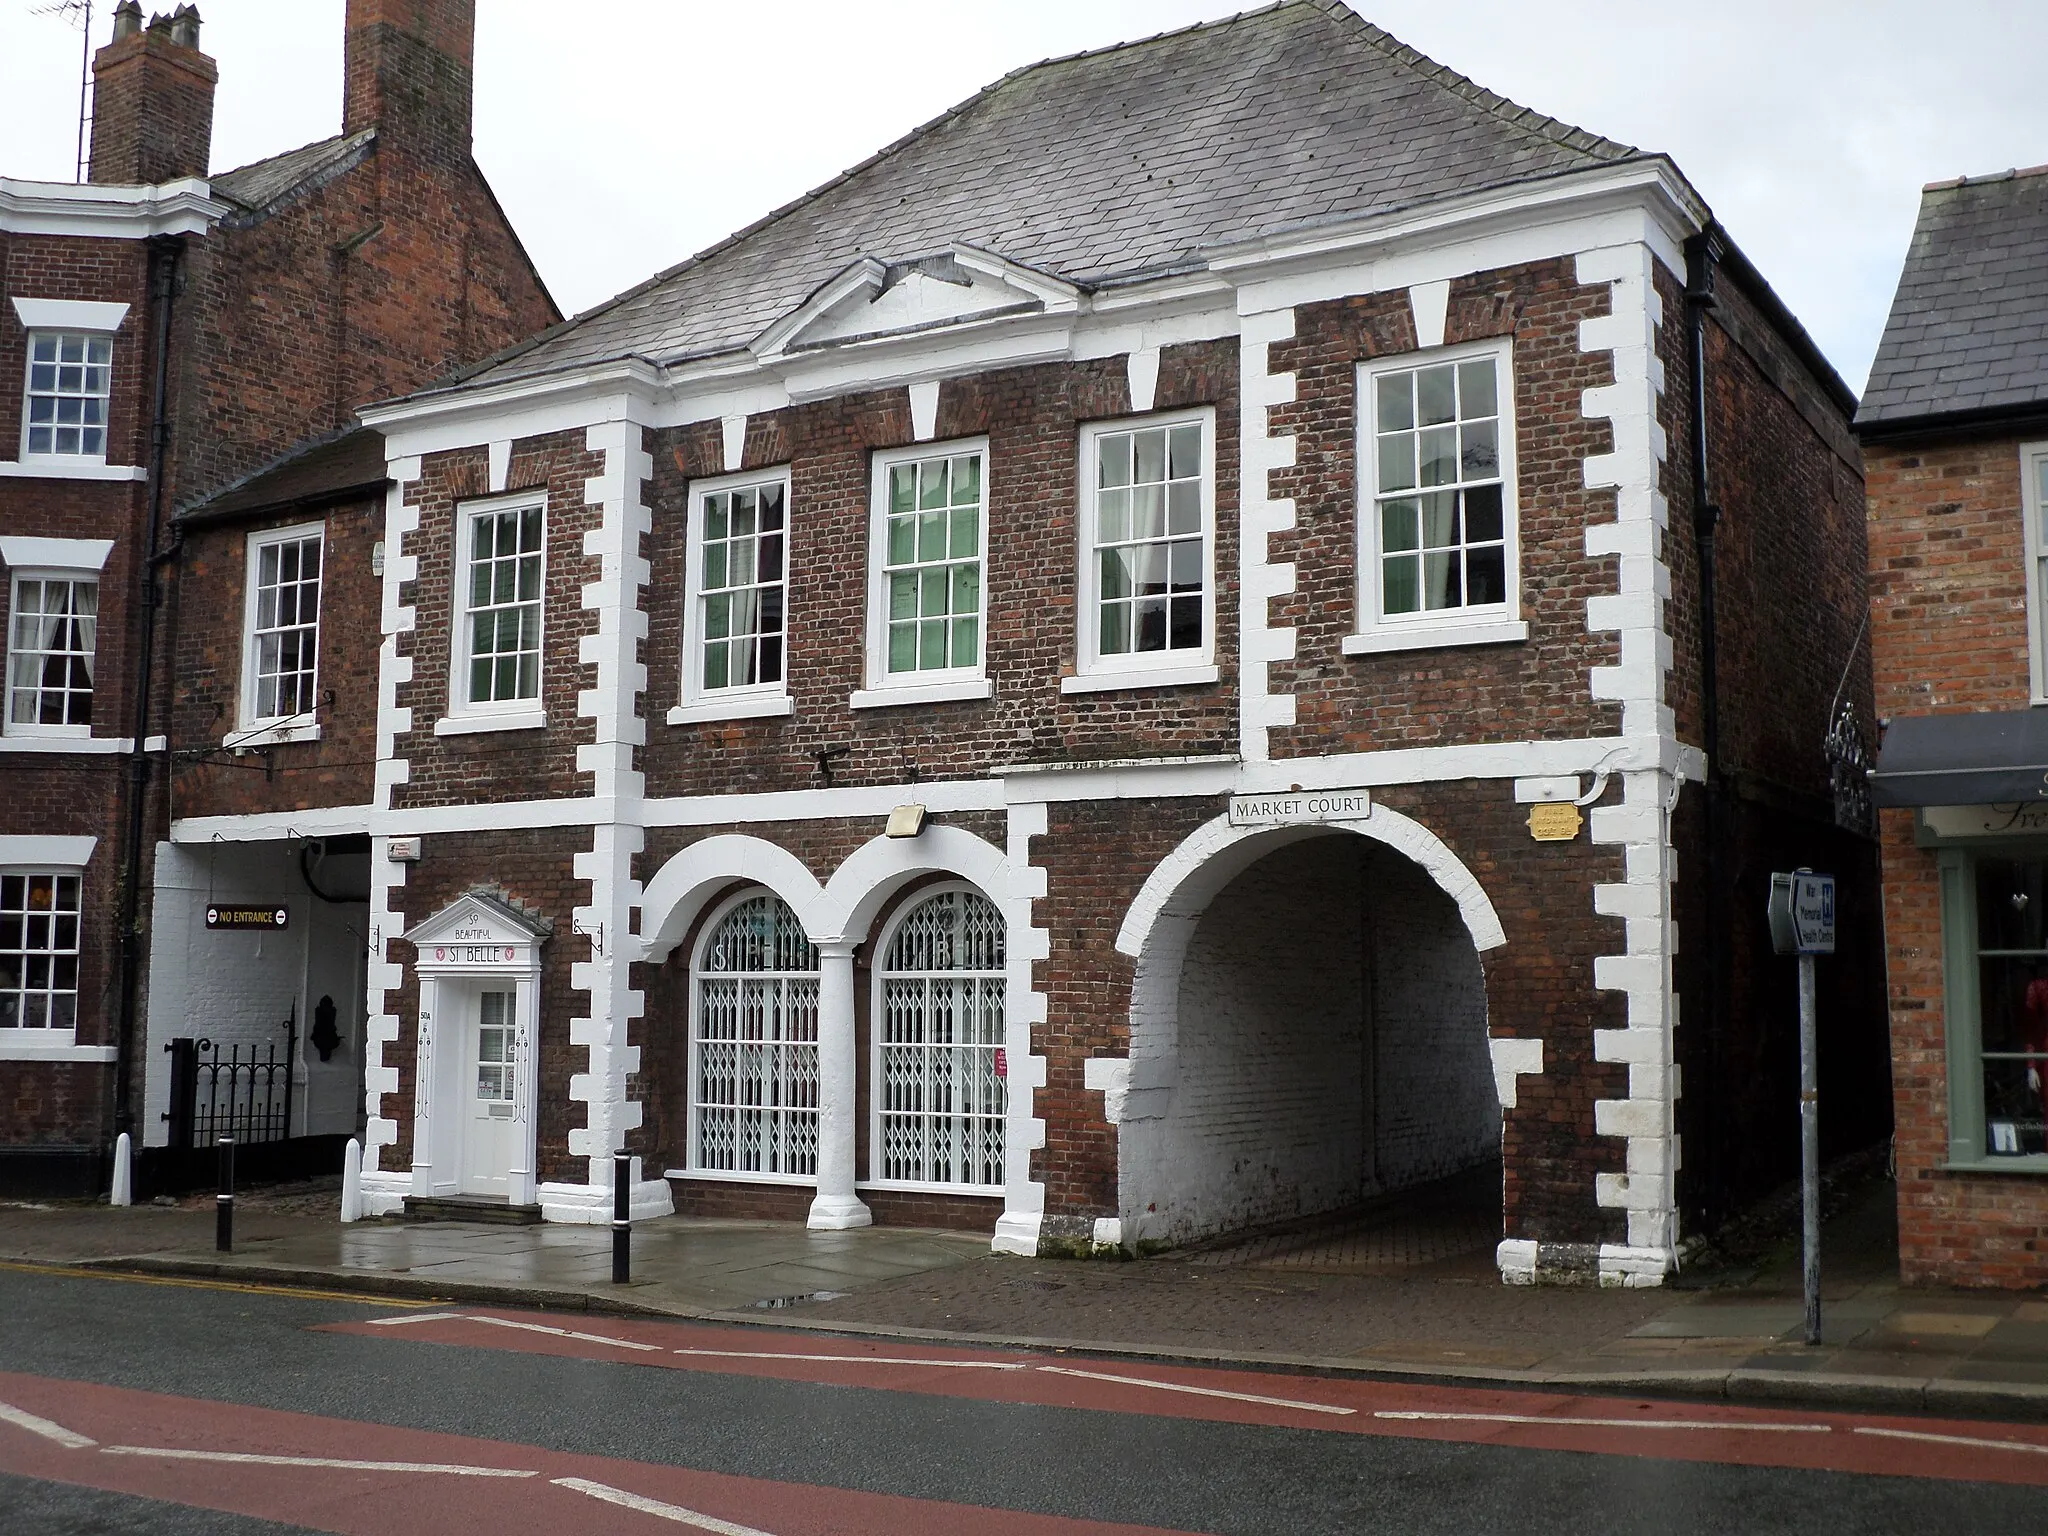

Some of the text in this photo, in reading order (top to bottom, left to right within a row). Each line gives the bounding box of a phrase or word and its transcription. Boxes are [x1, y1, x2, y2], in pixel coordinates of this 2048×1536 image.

[1236, 797, 1364, 817] MARKET COURT
[219, 911, 273, 923] NO ENTRANCE
[455, 929, 492, 940] BEAUTIFUL
[467, 946, 500, 962] BELLE
[420, 1011, 431, 1020] 50A
